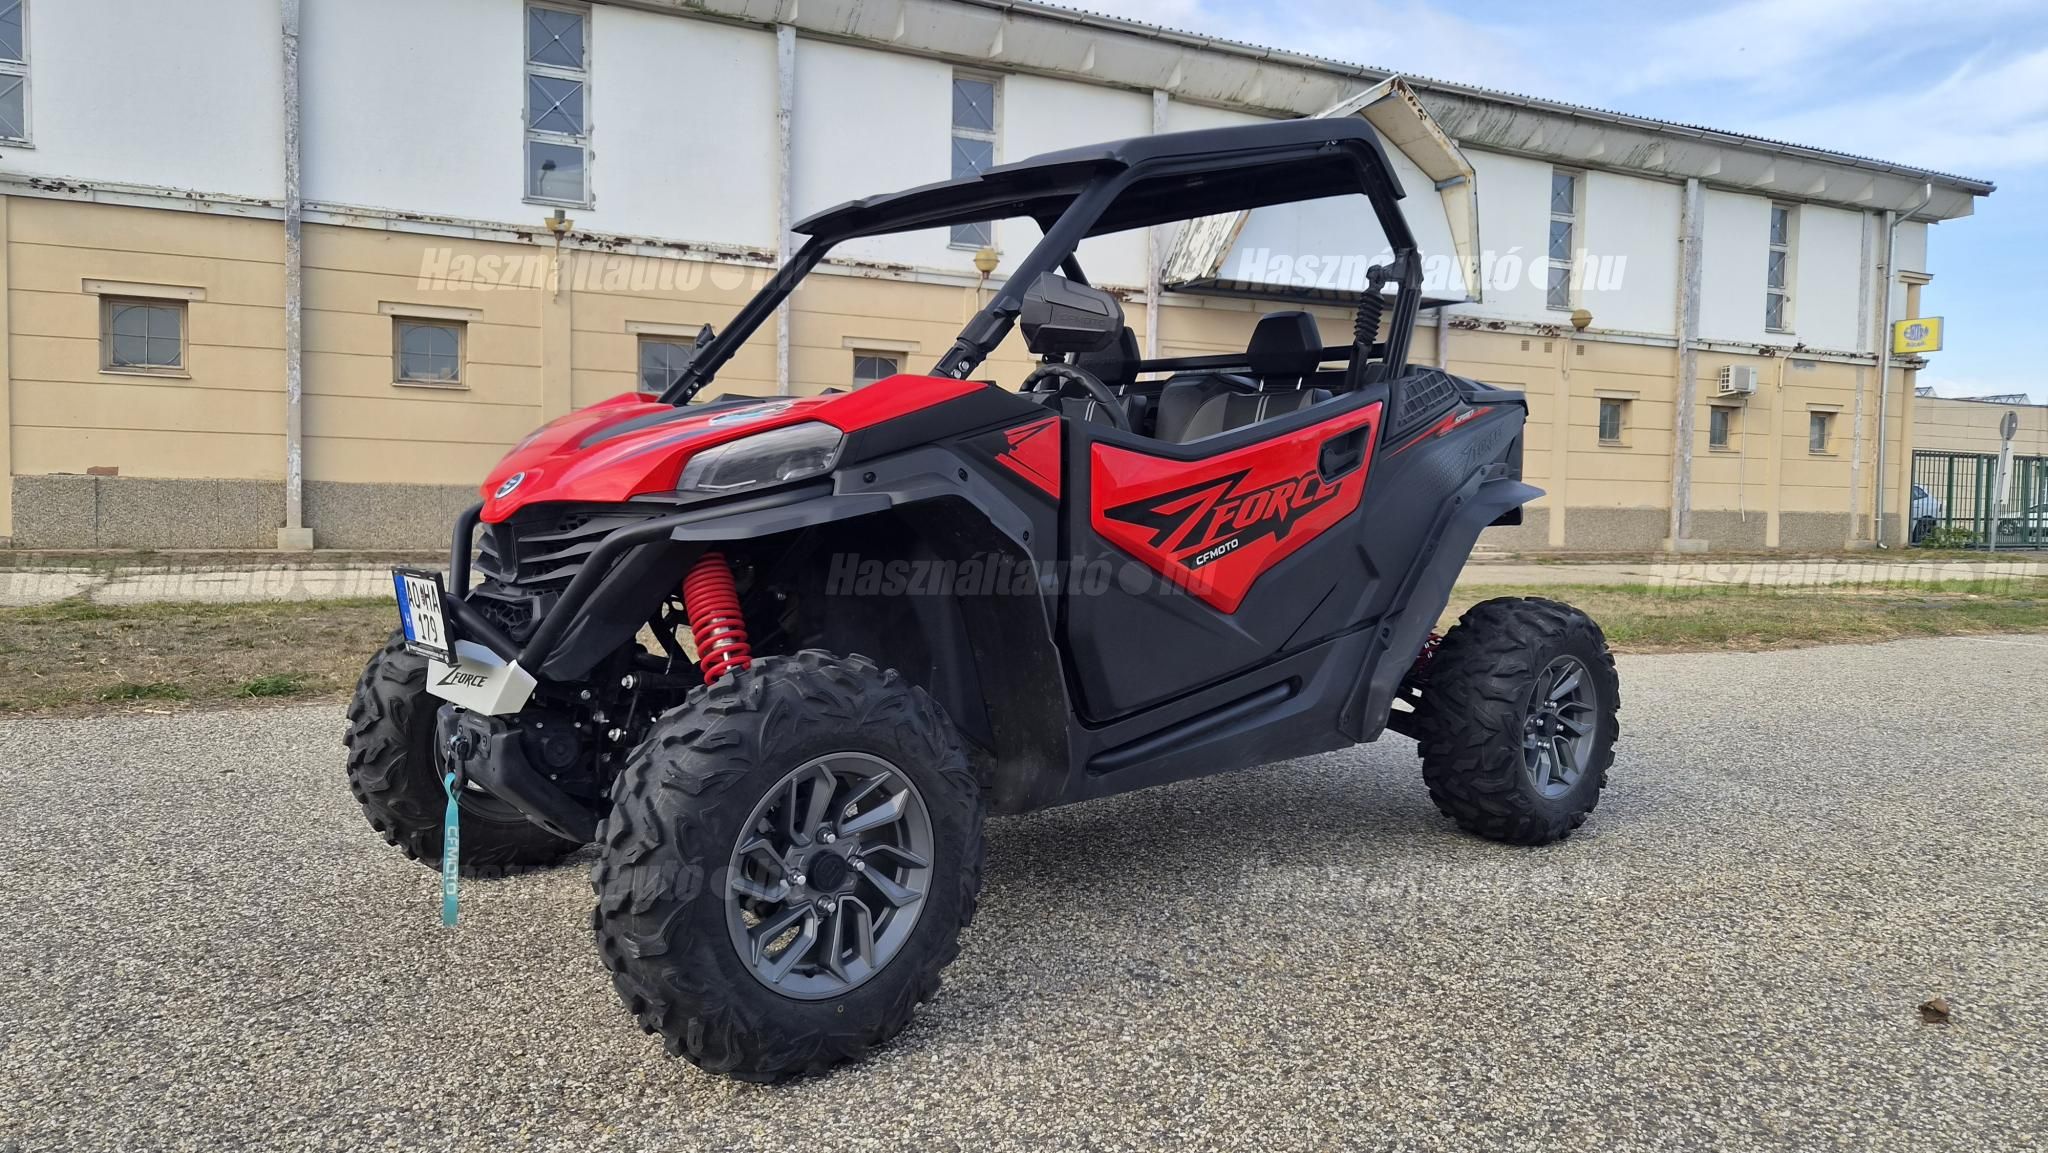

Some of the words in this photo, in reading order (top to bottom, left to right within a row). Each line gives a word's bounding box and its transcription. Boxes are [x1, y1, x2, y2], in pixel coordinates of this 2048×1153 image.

[1195, 538, 1239, 566] CFMOTO
[418, 612, 439, 643] 179
[445, 825, 459, 896] CFMOTO
